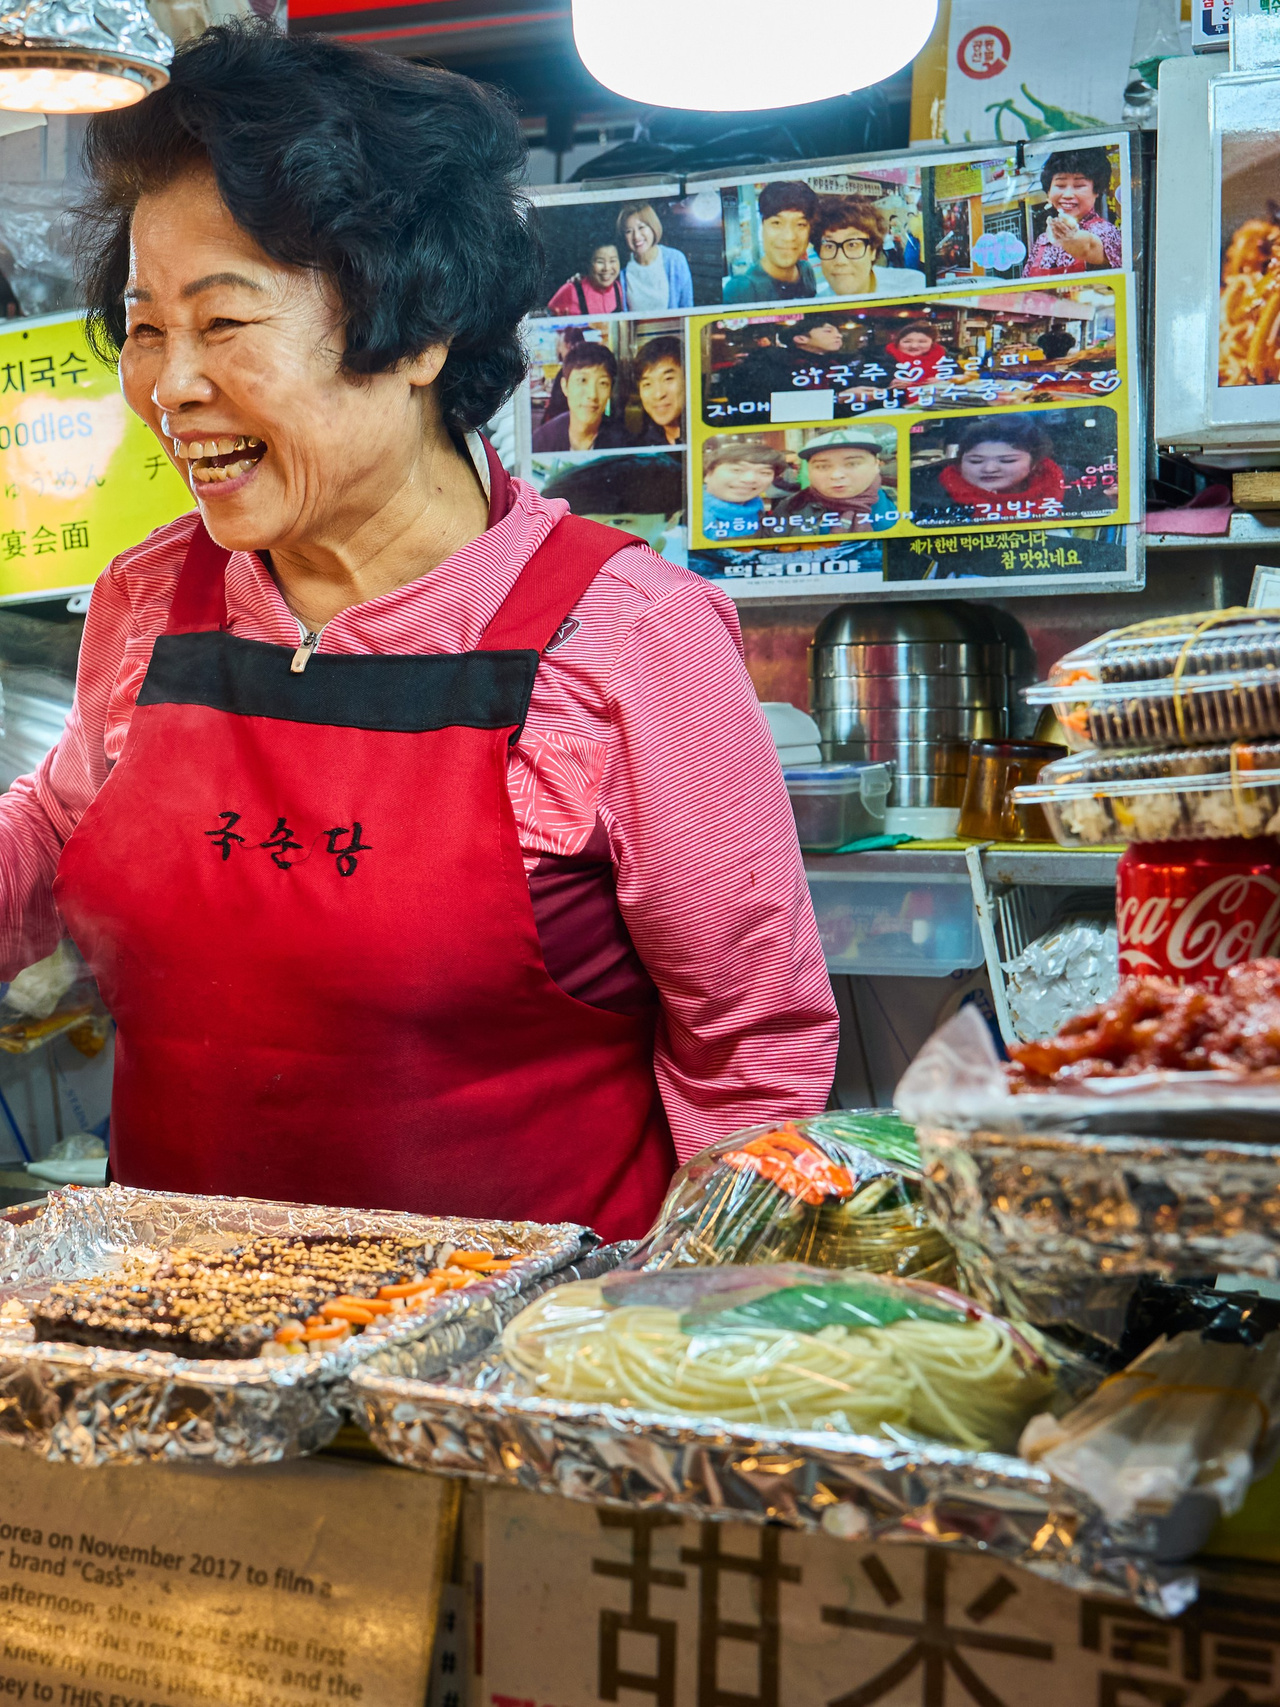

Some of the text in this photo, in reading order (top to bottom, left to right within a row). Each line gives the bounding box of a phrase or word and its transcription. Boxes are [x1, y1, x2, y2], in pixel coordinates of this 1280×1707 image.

[975, 497, 1064, 521] 김밥중
[0, 520, 90, 562] 宴会面
[909, 530, 1048, 556] 제가 한번 먹어보겠습니다
[1000, 549, 1083, 571] 참 맛있네요
[9, 1547, 67, 1577] brand
[47, 1531, 74, 1552] on
[78, 1532, 185, 1573] November
[188, 1551, 243, 1582] 2017
[246, 1564, 269, 1587] to
[272, 1566, 315, 1596] film
[32, 1679, 55, 1702] to
[280, 1667, 322, 1692] and
[326, 1672, 365, 1701] the
